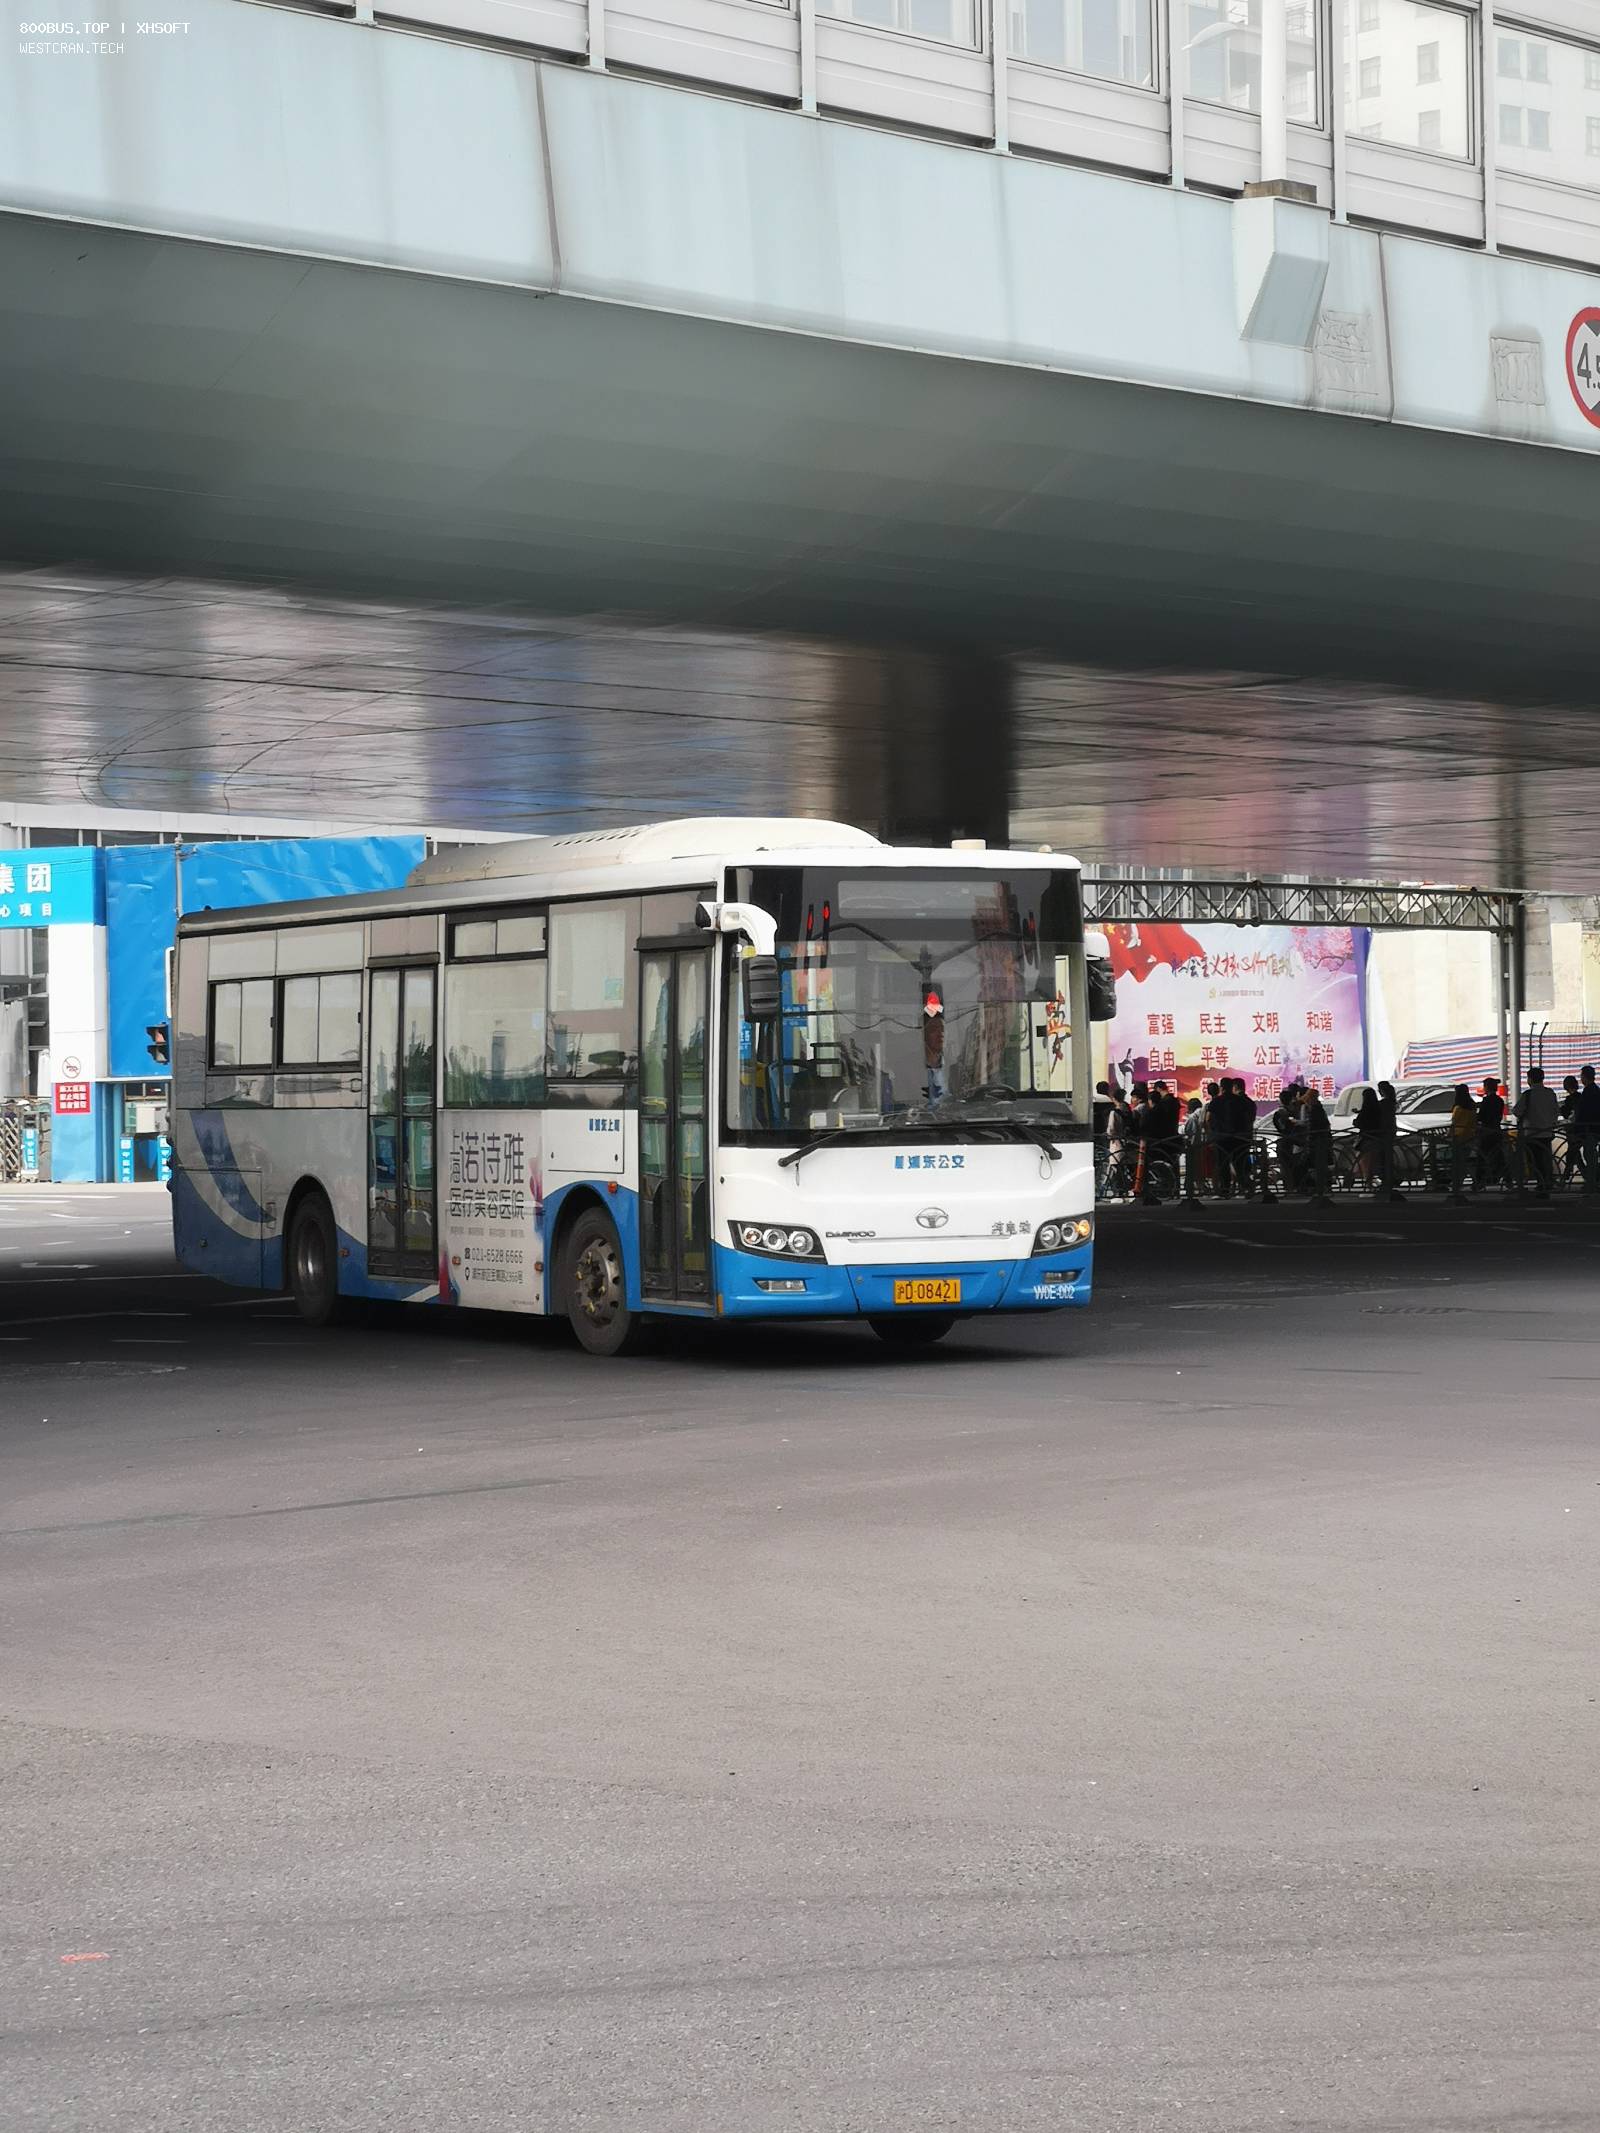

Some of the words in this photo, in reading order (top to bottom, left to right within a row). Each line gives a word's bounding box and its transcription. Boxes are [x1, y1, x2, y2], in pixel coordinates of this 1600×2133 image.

[1147, 1013, 1175, 1035] 富强
[1199, 1013, 1227, 1034] 民主
[1252, 1011, 1280, 1033] 文明
[1306, 1011, 1333, 1032] 和谐
[1148, 1047, 1176, 1071] 自由
[1201, 1045, 1229, 1069] 平等
[1254, 1045, 1281, 1066] 公正
[1308, 1043, 1334, 1065] 法治
[1254, 1076, 1282, 1101] 诚信
[450, 1186, 525, 1220] 医疗美容医院
